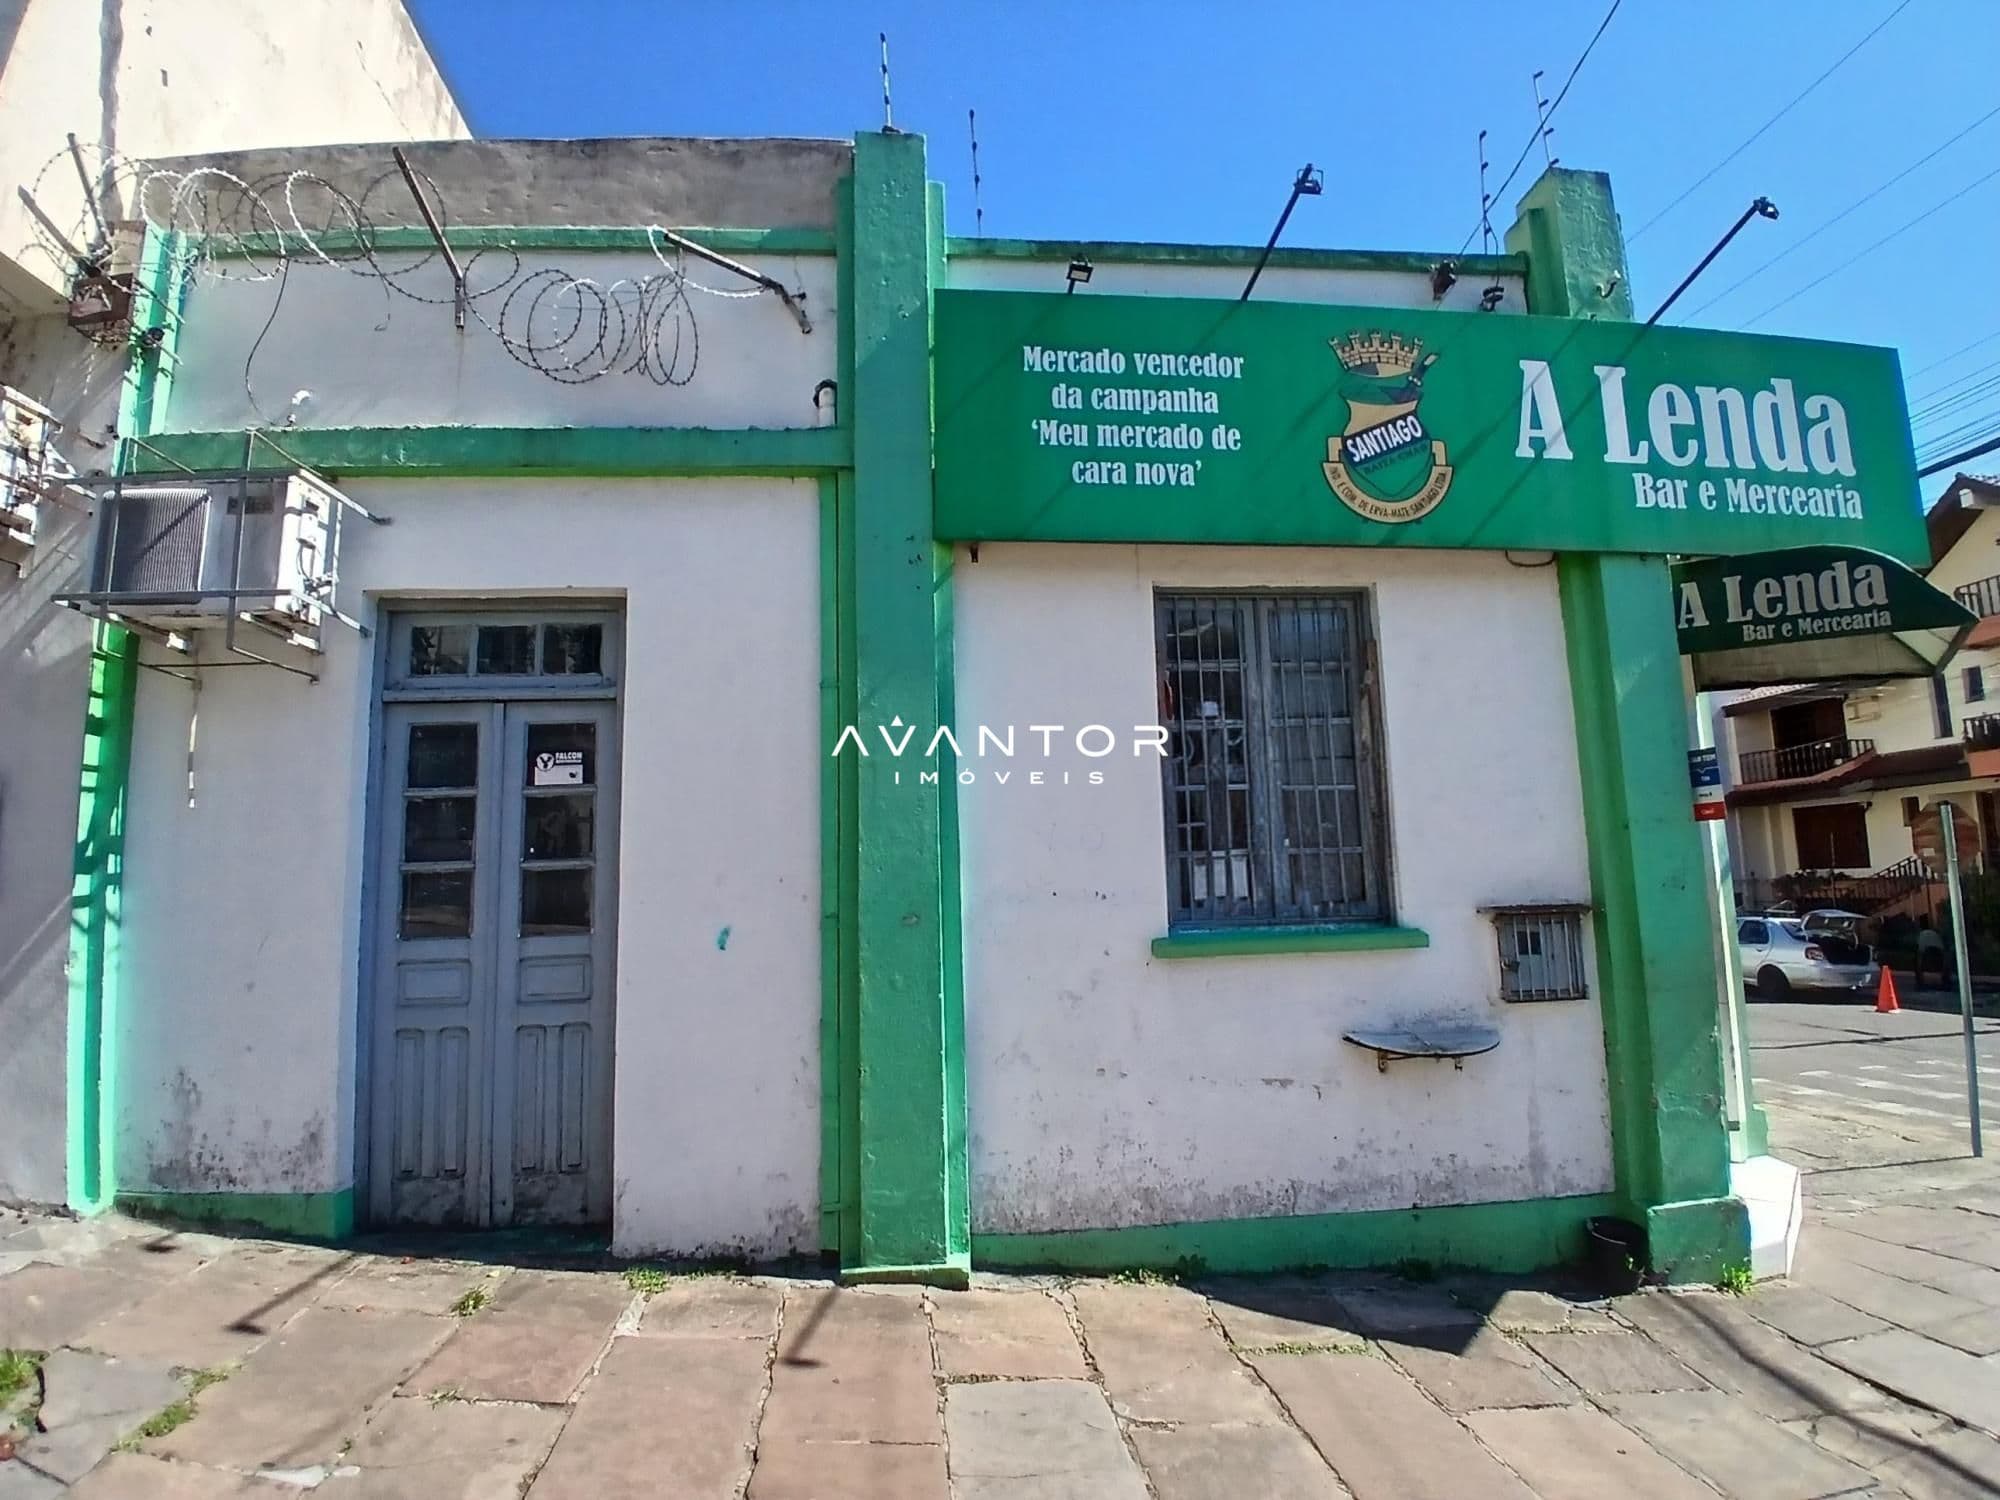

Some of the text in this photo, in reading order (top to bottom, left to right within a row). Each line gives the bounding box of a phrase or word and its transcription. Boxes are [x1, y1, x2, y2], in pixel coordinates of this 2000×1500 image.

[1023, 346, 1244, 379] Mercado vencedor
[1052, 383, 1219, 415] da campanha
[1515, 359, 1857, 477] A Lenda
[1097, 424, 1203, 450] mercado
[1211, 425, 1242, 451] de
[1347, 415, 1422, 462] SANTIAGO
[1072, 460, 1127, 484] cara
[1631, 472, 1864, 520] Bar e Mercearia
[1677, 560, 1889, 630] A Lenda
[1742, 607, 1893, 643] Bar e Mercearia
